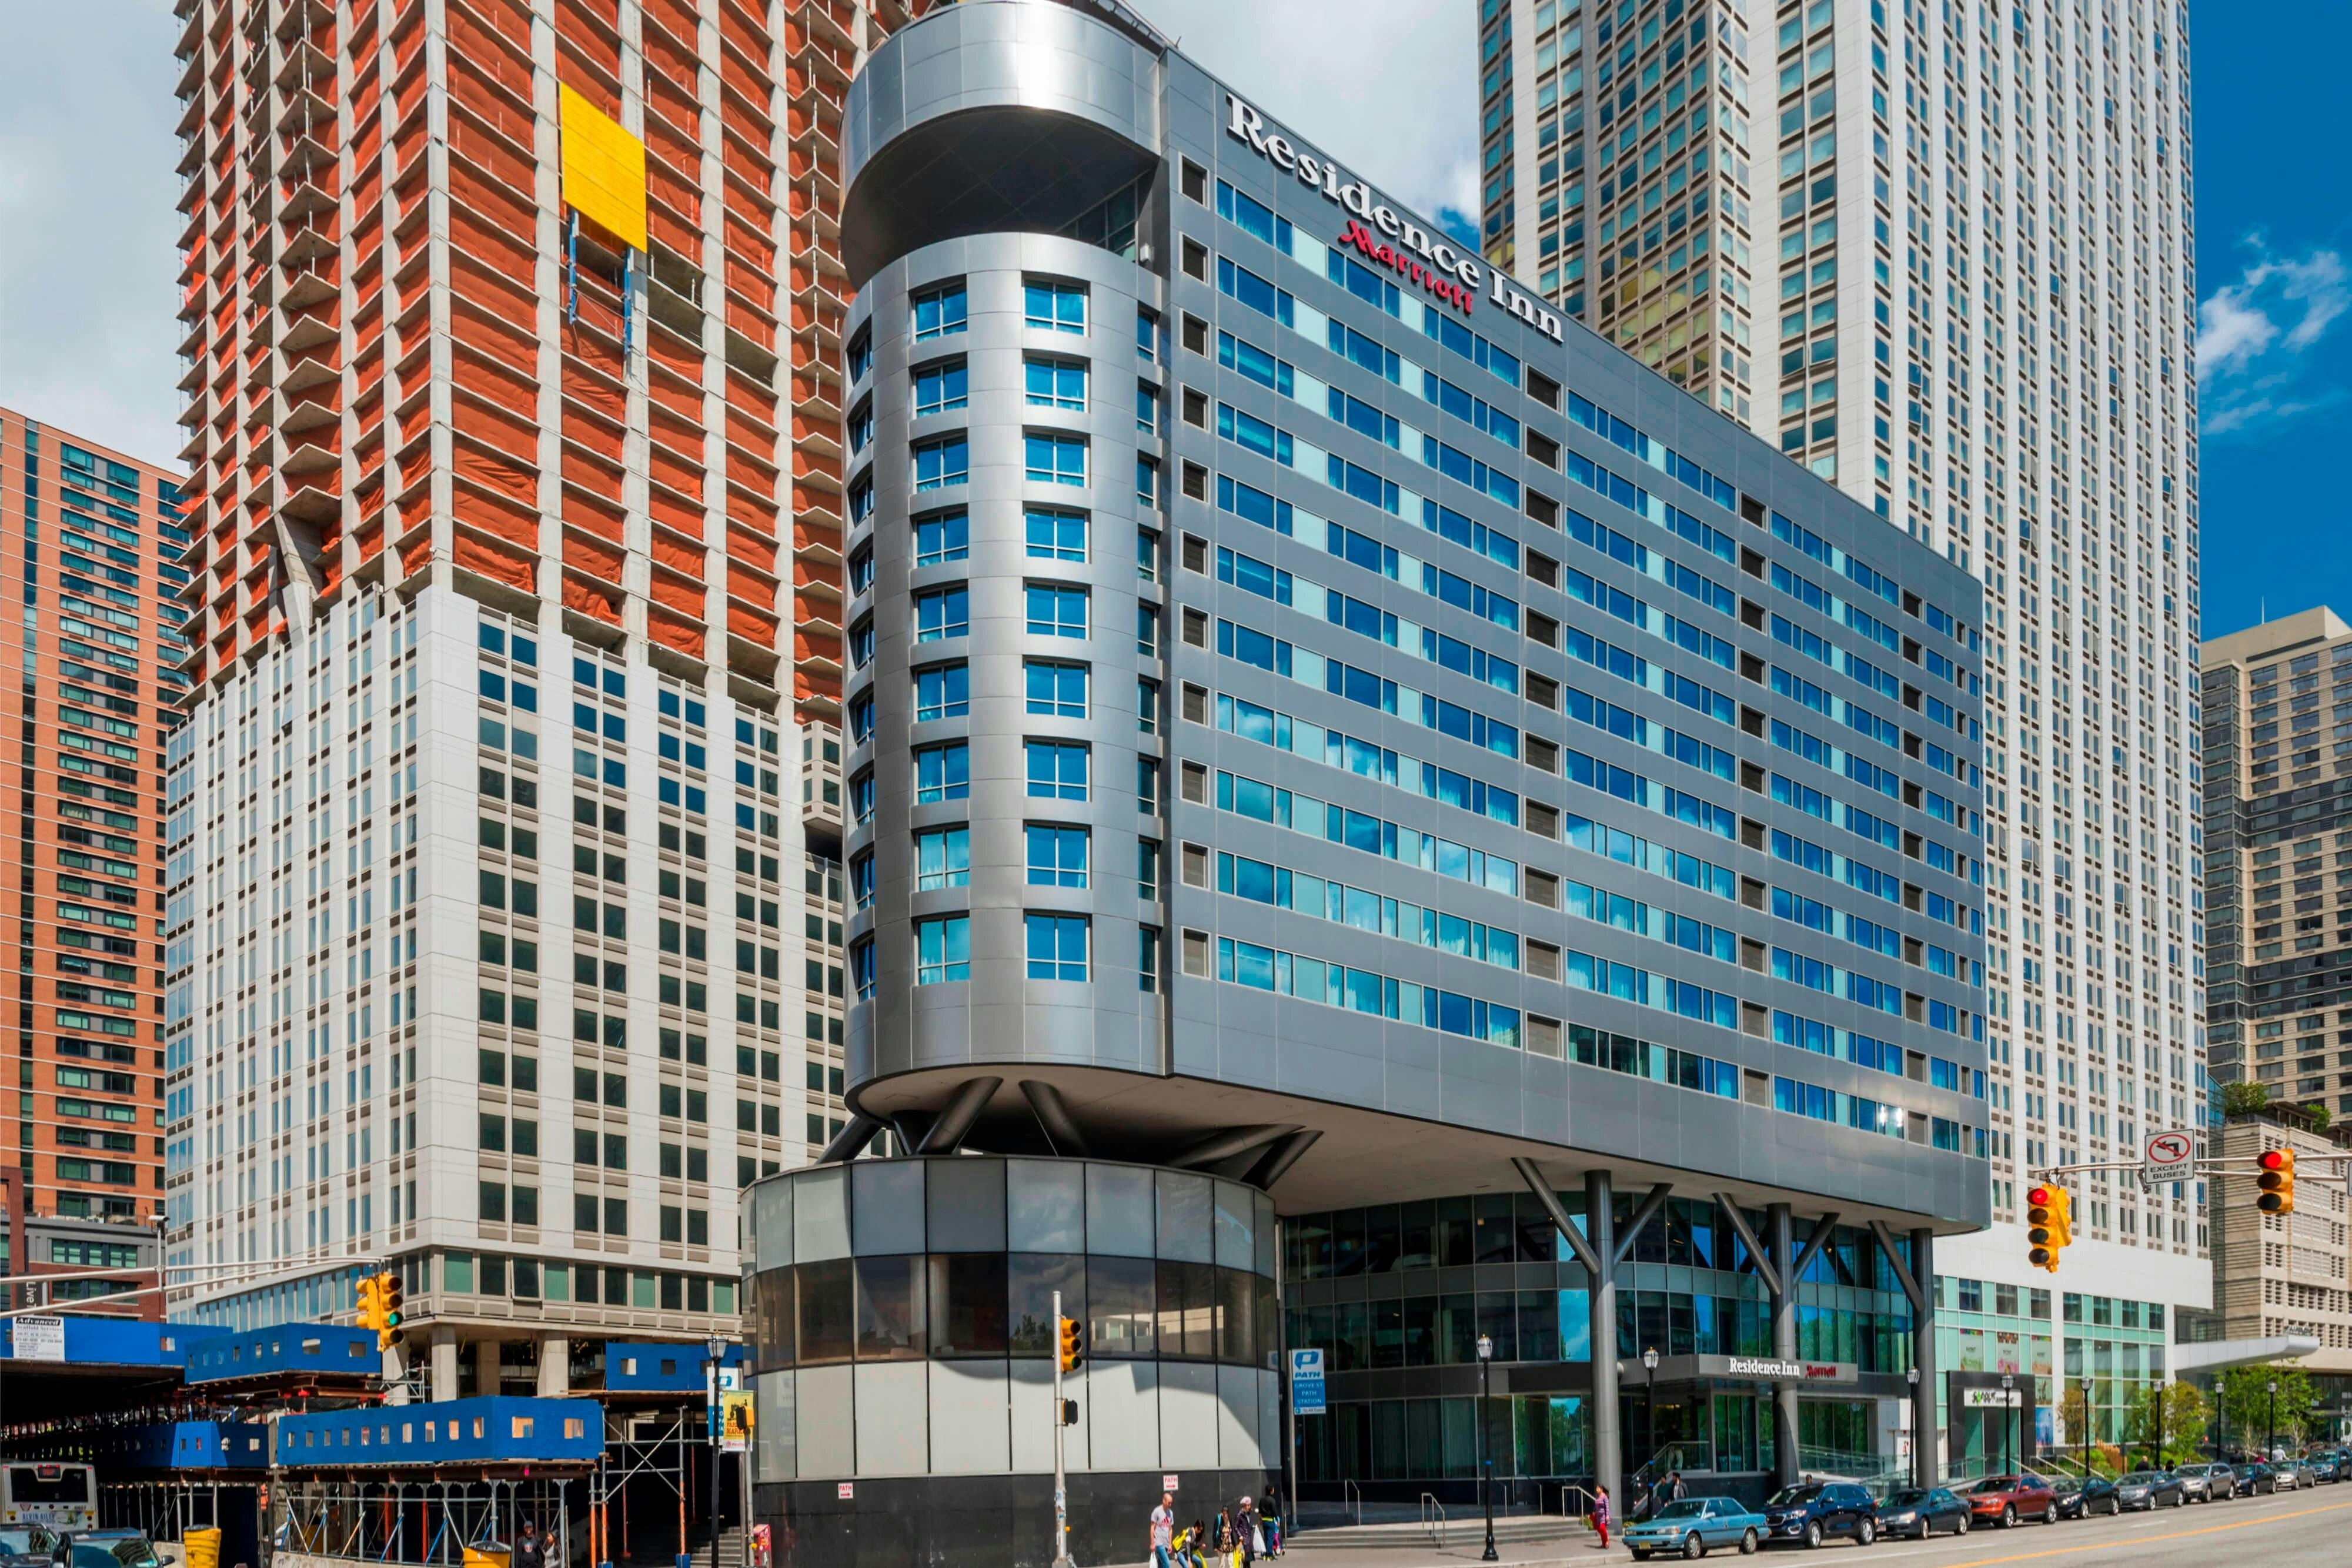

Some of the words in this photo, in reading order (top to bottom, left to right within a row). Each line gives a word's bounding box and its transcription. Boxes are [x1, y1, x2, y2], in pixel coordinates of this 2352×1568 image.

[1226, 93, 1480, 289] Residence
[1489, 269, 1564, 344] Inn
[1338, 220, 1474, 315] Marriott
[2150, 1163, 2189, 1172] EXCEPT
[2153, 1170, 2186, 1179] BUSES
[17, 1318, 59, 1326] Advanced
[1729, 1358, 1780, 1375] Residence
[1782, 1360, 1800, 1376] Inn
[1805, 1363, 1836, 1379] Marriott
